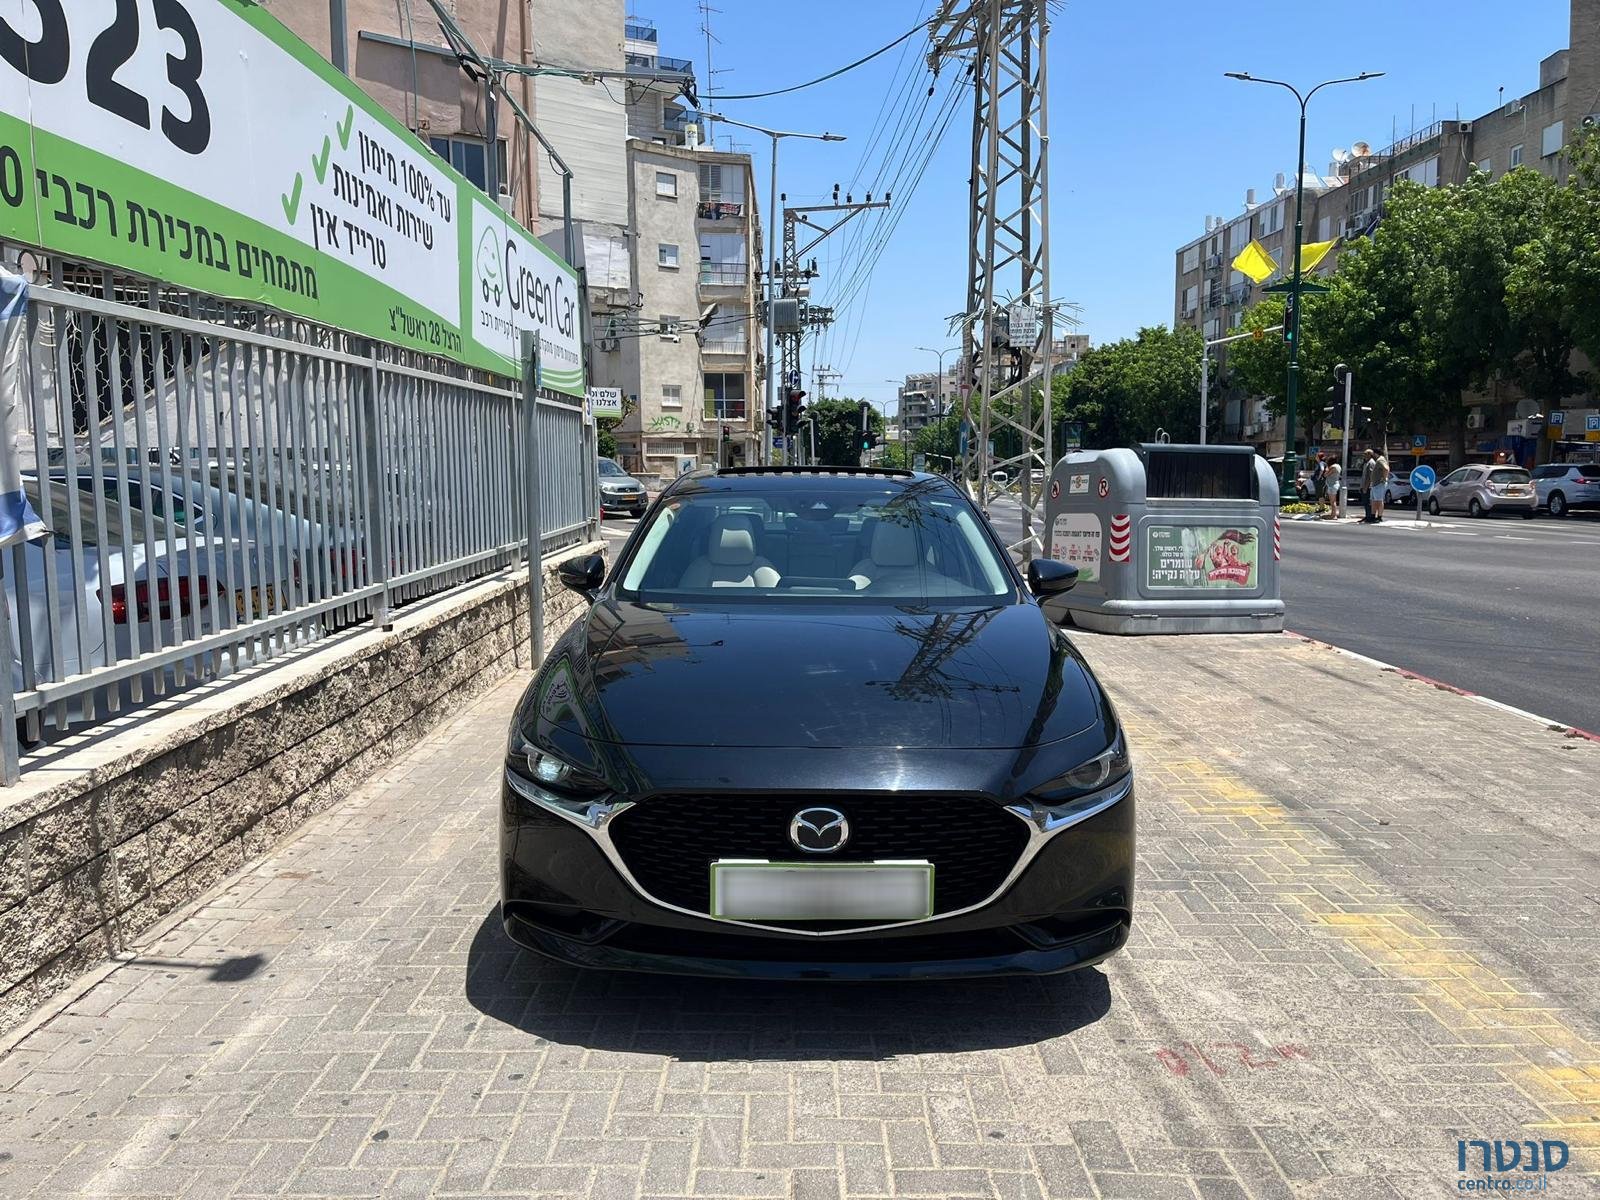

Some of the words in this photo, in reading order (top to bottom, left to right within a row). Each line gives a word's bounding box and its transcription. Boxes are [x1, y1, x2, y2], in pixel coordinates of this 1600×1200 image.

[359, 130, 398, 186] מימון
[36, 168, 118, 238] רכבי
[332, 163, 393, 228] ואמינות
[400, 159, 435, 213] 100%
[436, 190, 451, 223] עד
[126, 200, 231, 273] במכירת
[310, 203, 340, 250] אין
[343, 221, 387, 270] טרייד
[396, 203, 434, 250] שירות
[236, 240, 318, 301] מתמחים
[505, 240, 553, 328] Green
[555, 275, 576, 340] Car
[388, 306, 428, 340] ראשל"צ
[429, 320, 441, 344] 28
[442, 327, 463, 353] הרצל
[481, 310, 493, 328] רכב
[596, 399, 617, 407] אצלנו
[600, 390, 617, 398] שלם
[1152, 569, 1178, 581] נקייה!
[1160, 558, 1192, 568] שומרים
